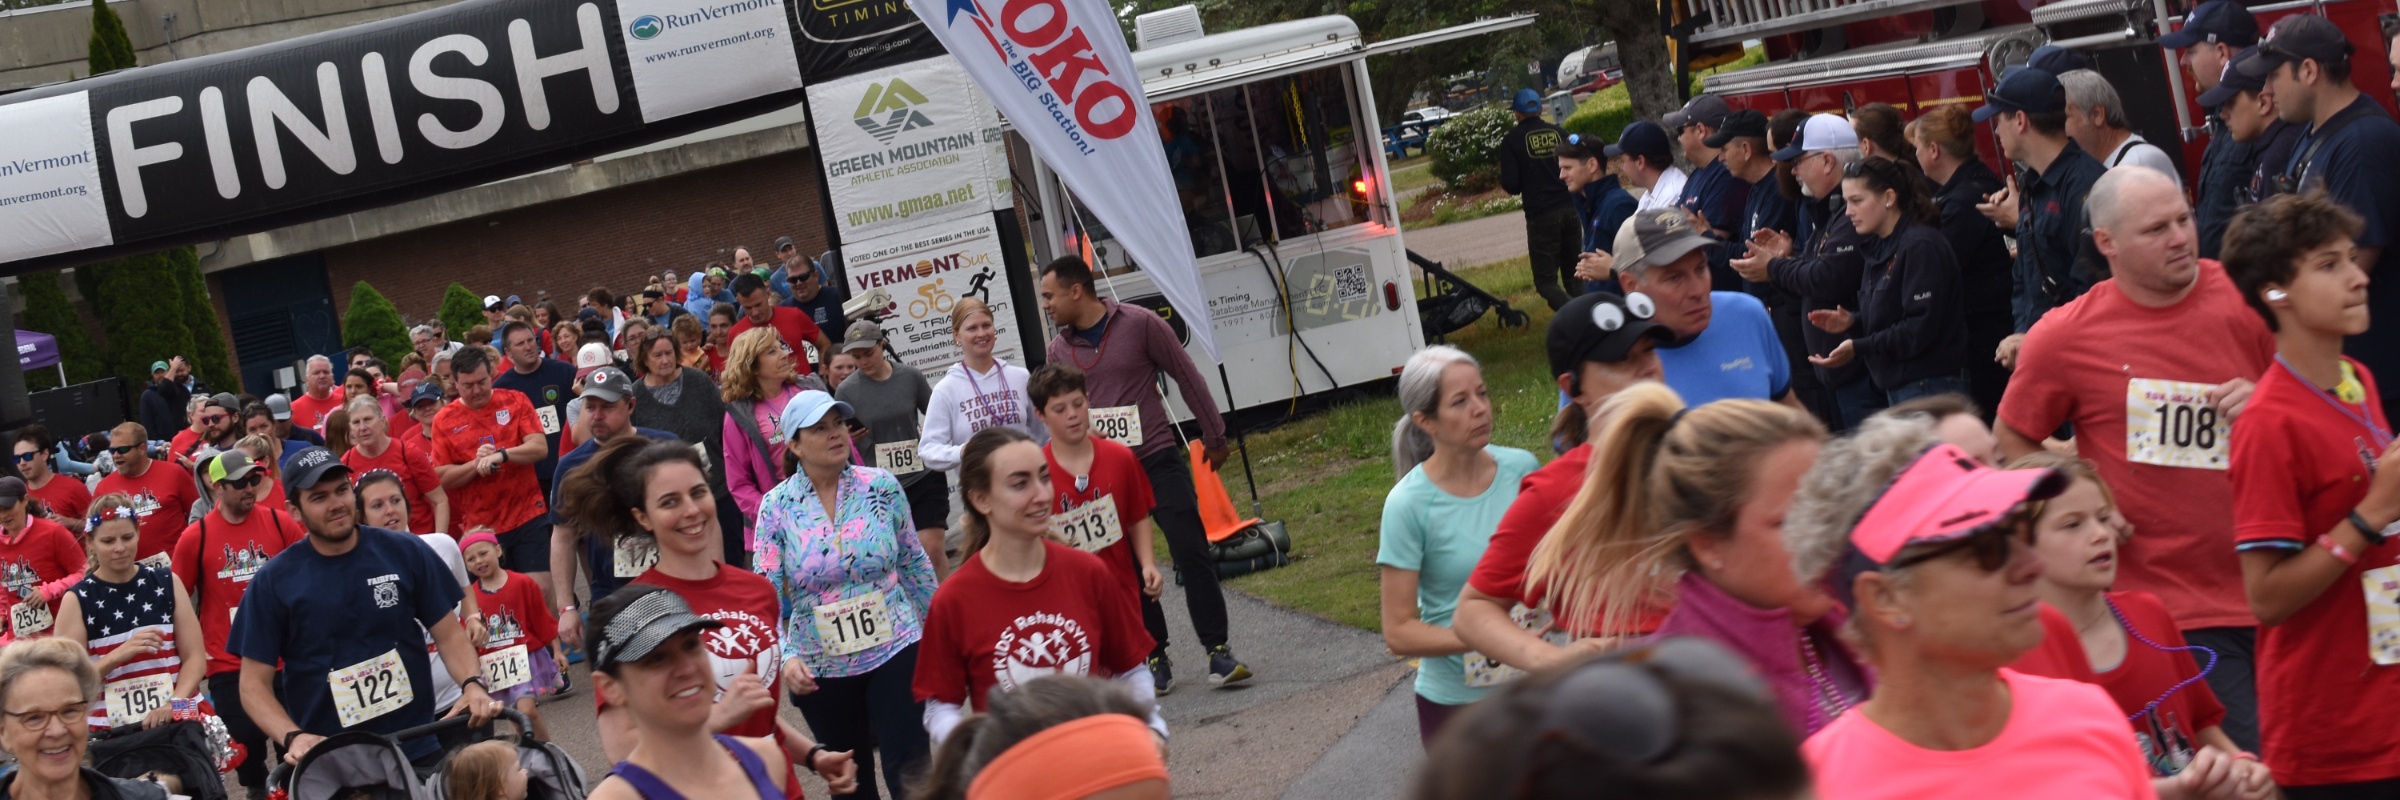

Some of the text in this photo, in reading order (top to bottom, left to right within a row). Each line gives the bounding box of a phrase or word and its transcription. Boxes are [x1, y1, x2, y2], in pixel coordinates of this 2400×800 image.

[645, 26, 775, 64] www.runvermont.org
[847, 37, 911, 58] 802timing.com
[107, 2, 620, 219] FINISH
[1001, 39, 1096, 156] The BIG Station!
[829, 131, 975, 178] GREEN MOUNTAIN
[850, 153, 960, 186] ATHLETIC ASSOCIATION
[847, 182, 976, 227] www.gmaa.net
[849, 225, 991, 264] VOTED ONE OF THE BEST SERIES IN THE USA
[1218, 292, 1251, 306] Timing
[1222, 316, 1245, 328] 1997
[959, 390, 1021, 413] STRONGER
[965, 401, 1021, 422] TOUGHER
[970, 412, 1021, 433] BRAVER
[1096, 416, 1129, 439] 289
[2155, 403, 2216, 450] 108
[298, 449, 330, 467] FAIRFAX
[308, 455, 329, 467] FIRE
[886, 449, 913, 469] 169
[1064, 513, 1107, 547] 213
[366, 573, 400, 586] FAIRFAX
[15, 607, 42, 630] 252
[832, 608, 875, 643] 116
[1013, 610, 1092, 652] RehabGYM
[490, 657, 519, 683] 214
[121, 687, 160, 716] 195
[350, 668, 398, 709] 122
